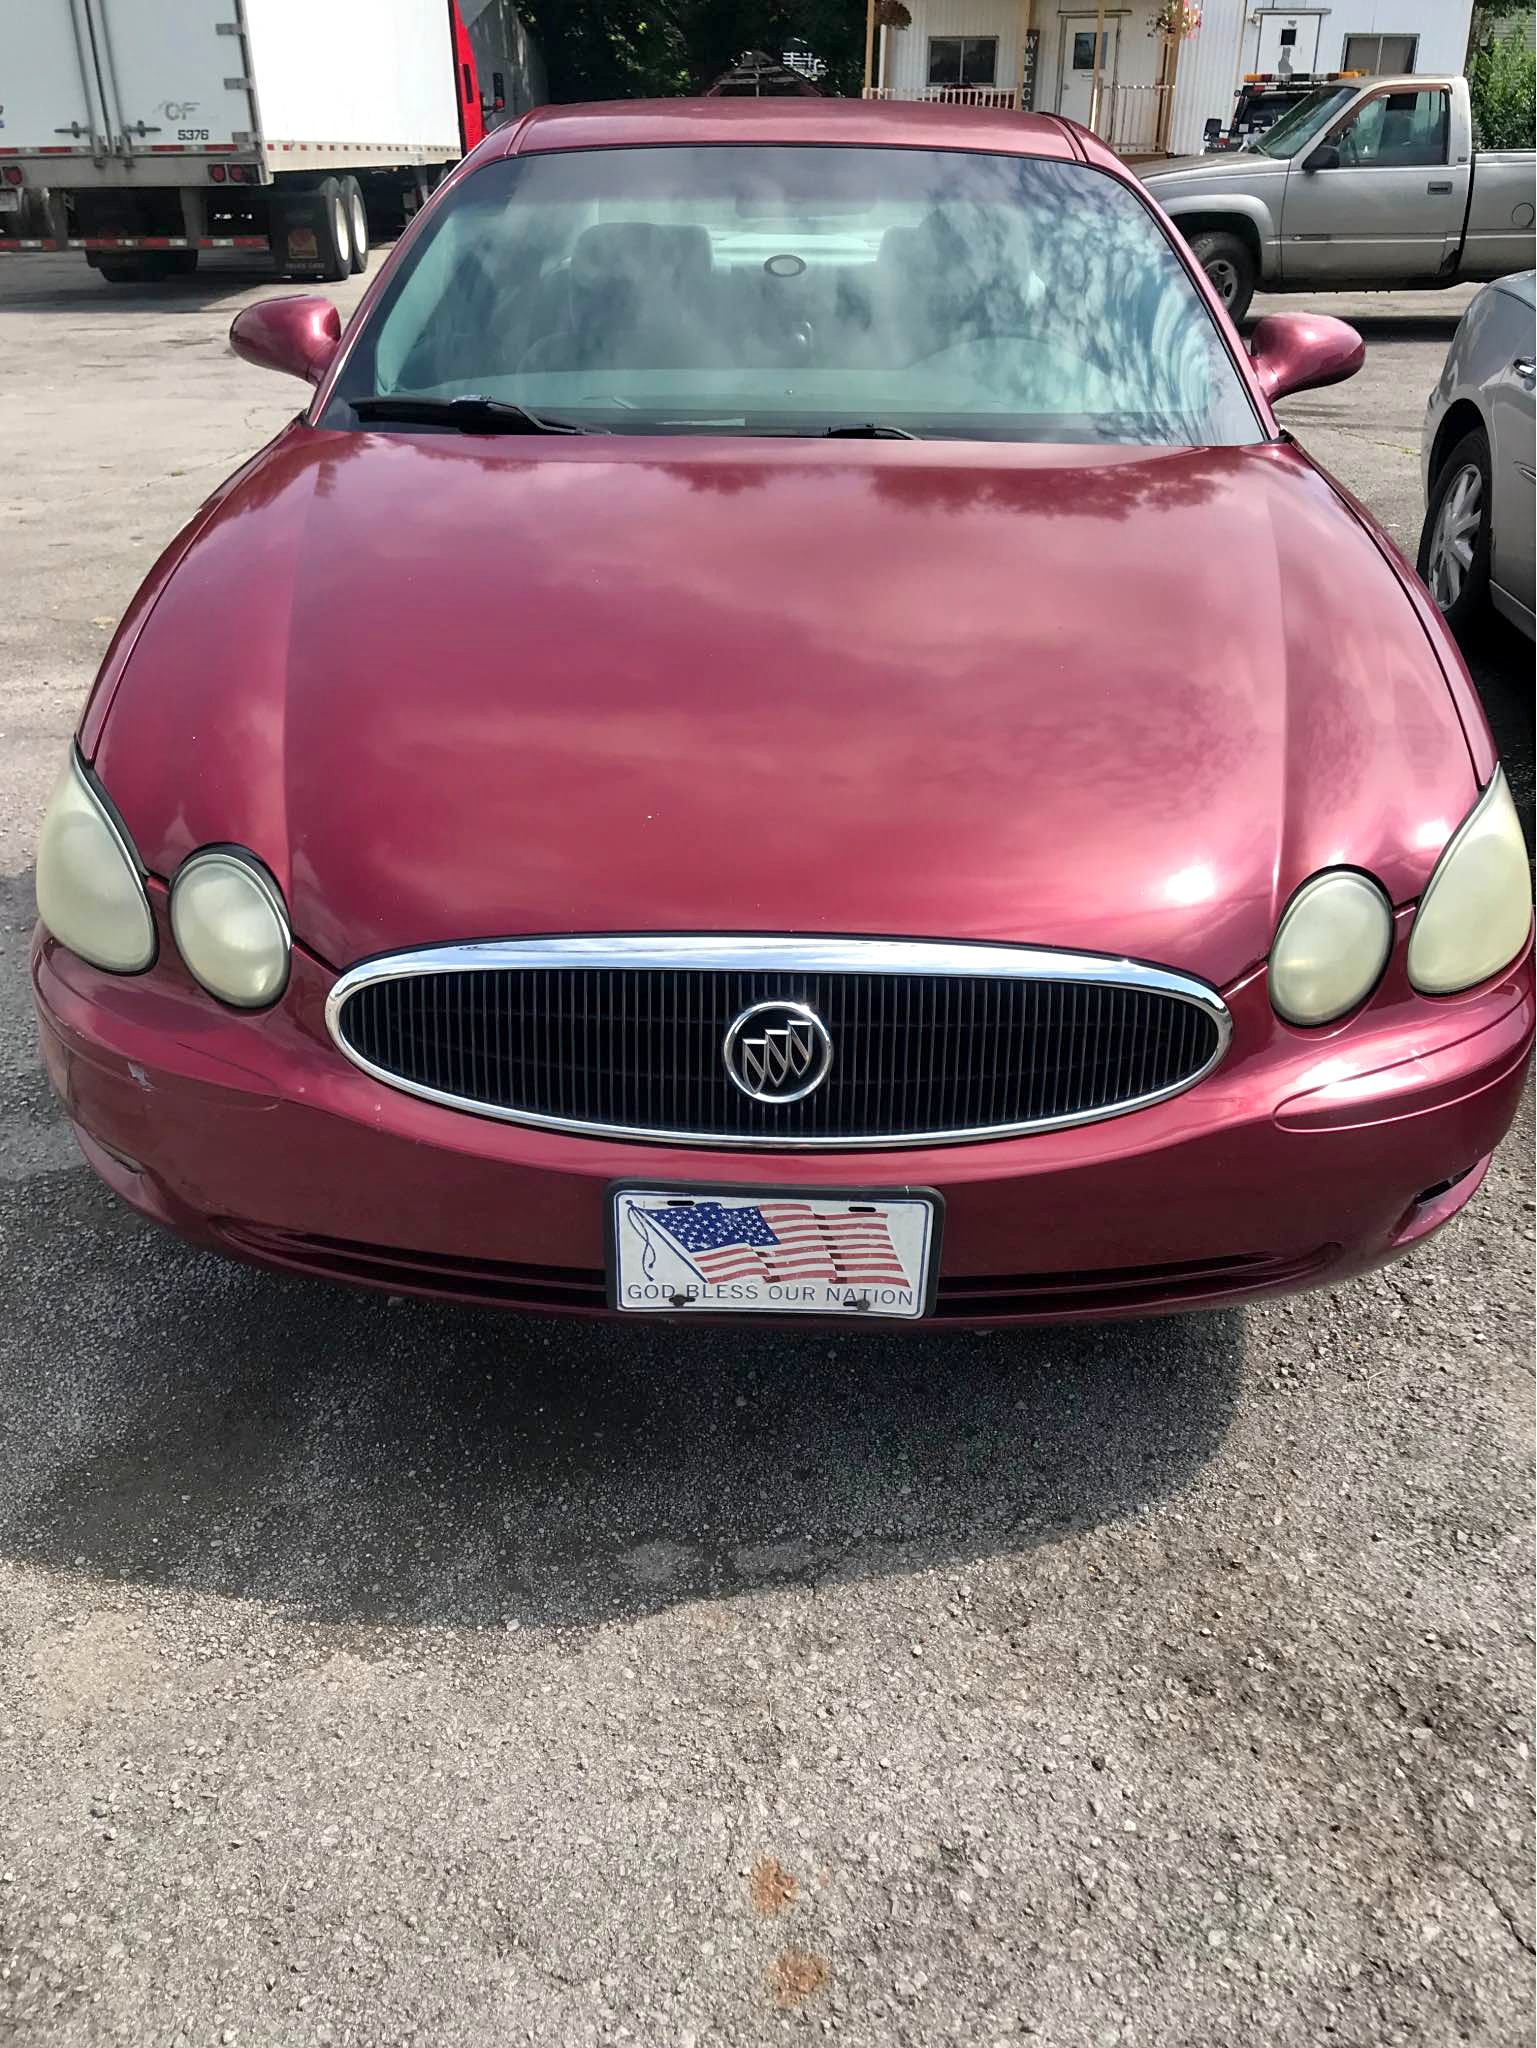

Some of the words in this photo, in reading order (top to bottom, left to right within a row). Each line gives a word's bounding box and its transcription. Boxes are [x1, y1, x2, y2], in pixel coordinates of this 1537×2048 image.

[177, 129, 209, 141] 5376
[627, 1284, 676, 1299] GOD
[686, 1283, 759, 1299] BLESS
[768, 1285, 816, 1301] OUR
[826, 1287, 914, 1306] NATION
